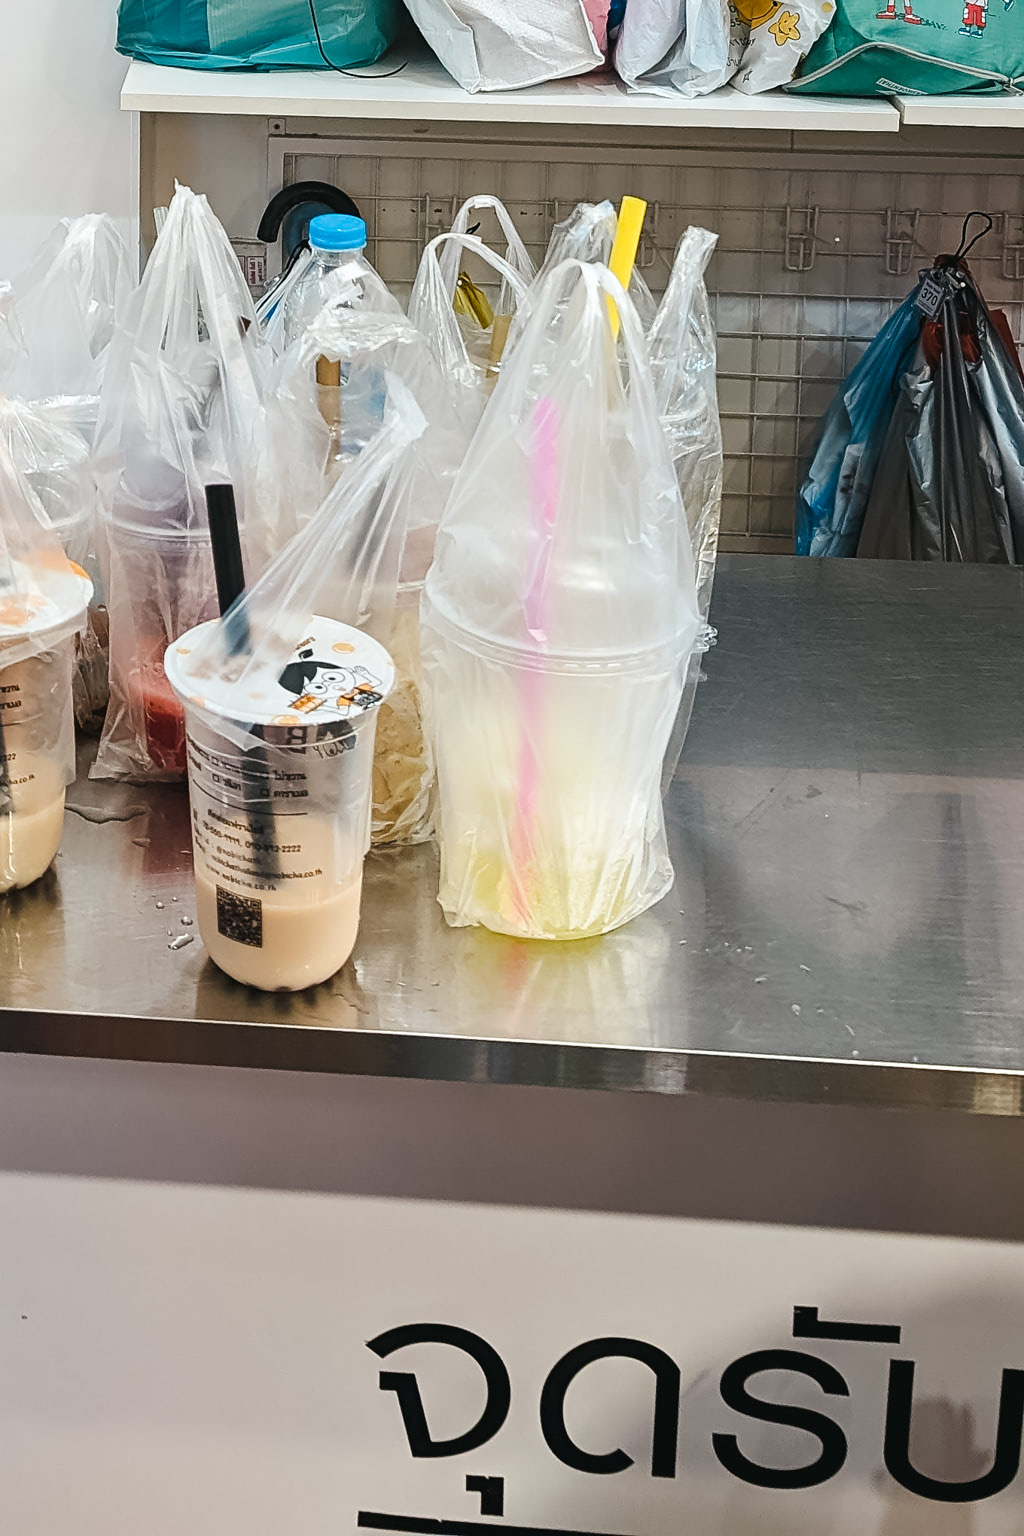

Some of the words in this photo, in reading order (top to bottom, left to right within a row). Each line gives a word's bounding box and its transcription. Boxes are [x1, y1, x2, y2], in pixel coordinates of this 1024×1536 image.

[922, 288, 938, 306] 370
[364, 1305, 1024, 1517] จุดรับ
